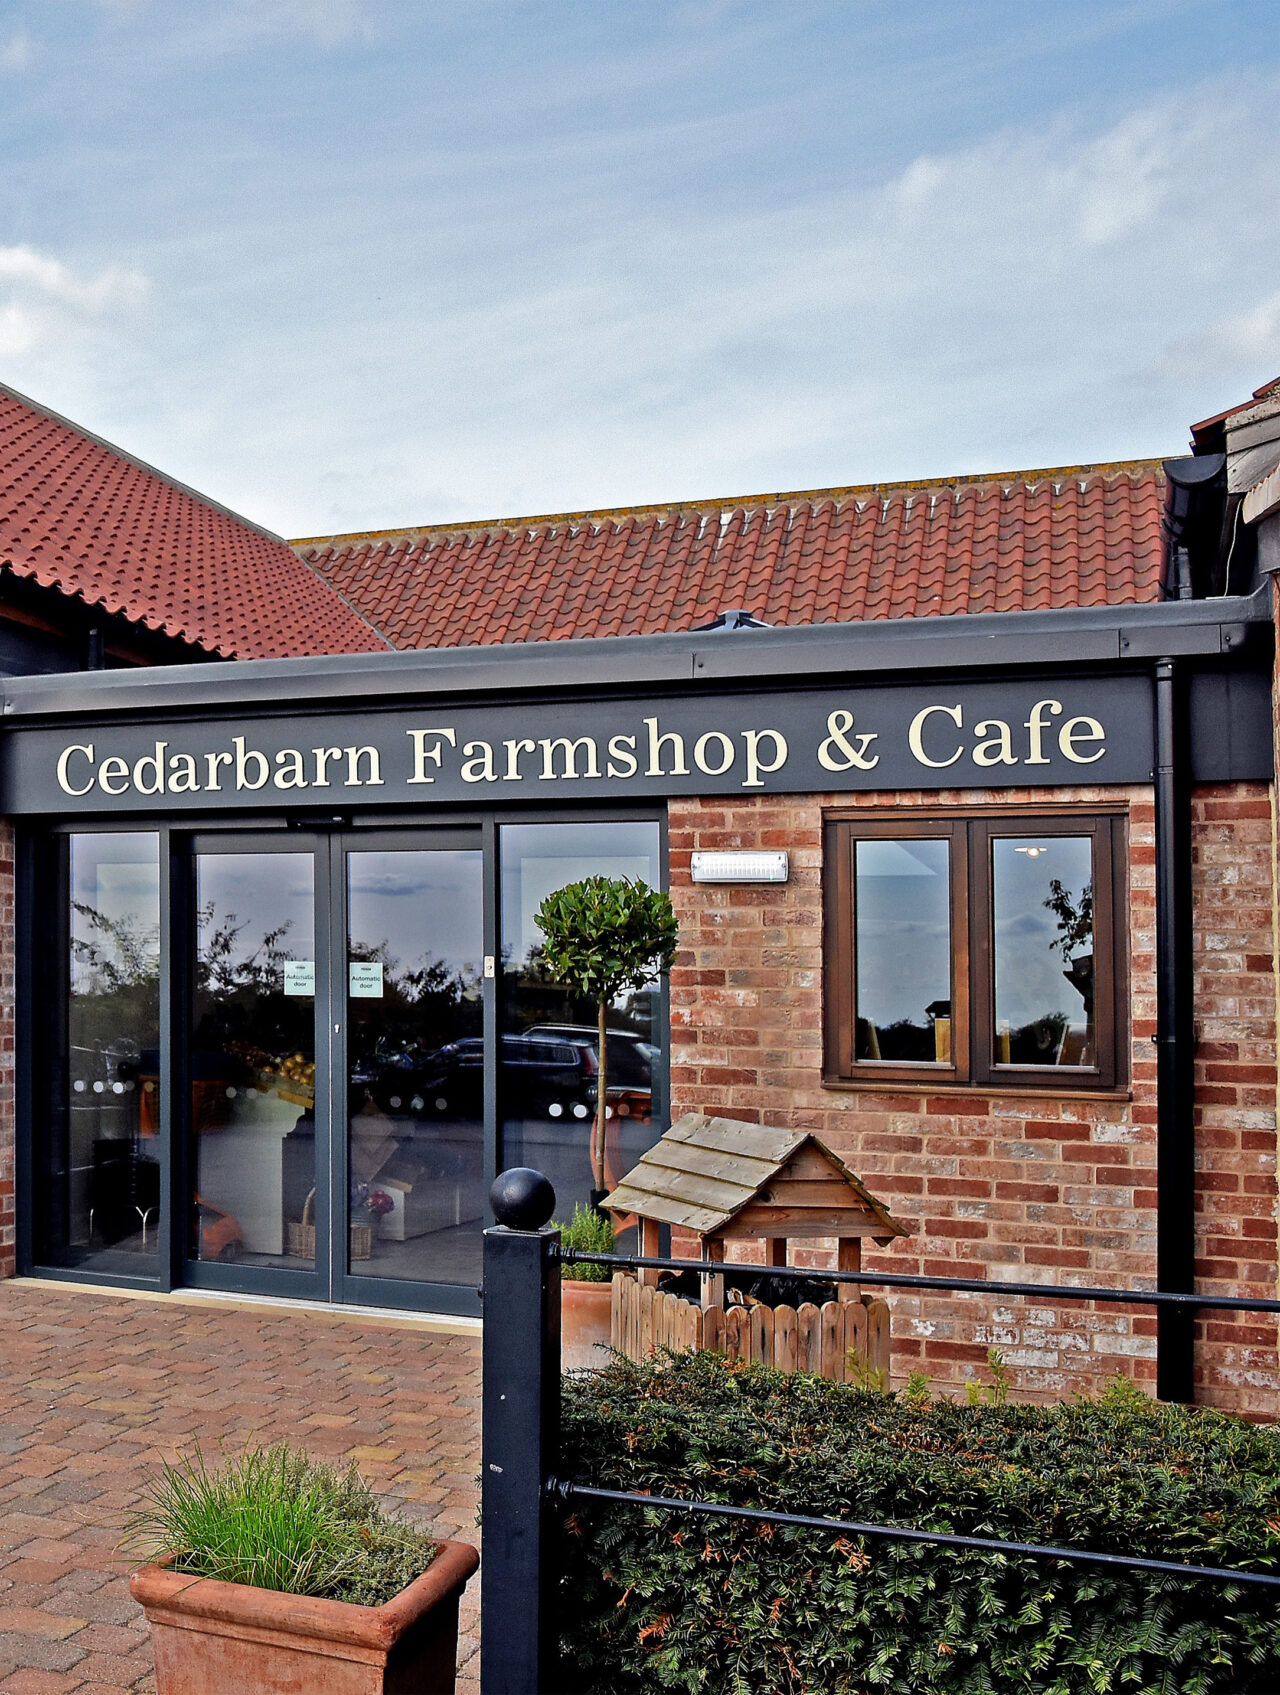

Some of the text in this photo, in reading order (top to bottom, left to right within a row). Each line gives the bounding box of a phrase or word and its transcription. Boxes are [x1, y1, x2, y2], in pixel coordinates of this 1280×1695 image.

[55, 698, 1107, 797] Cedarbarn Farmshop & Cafe
